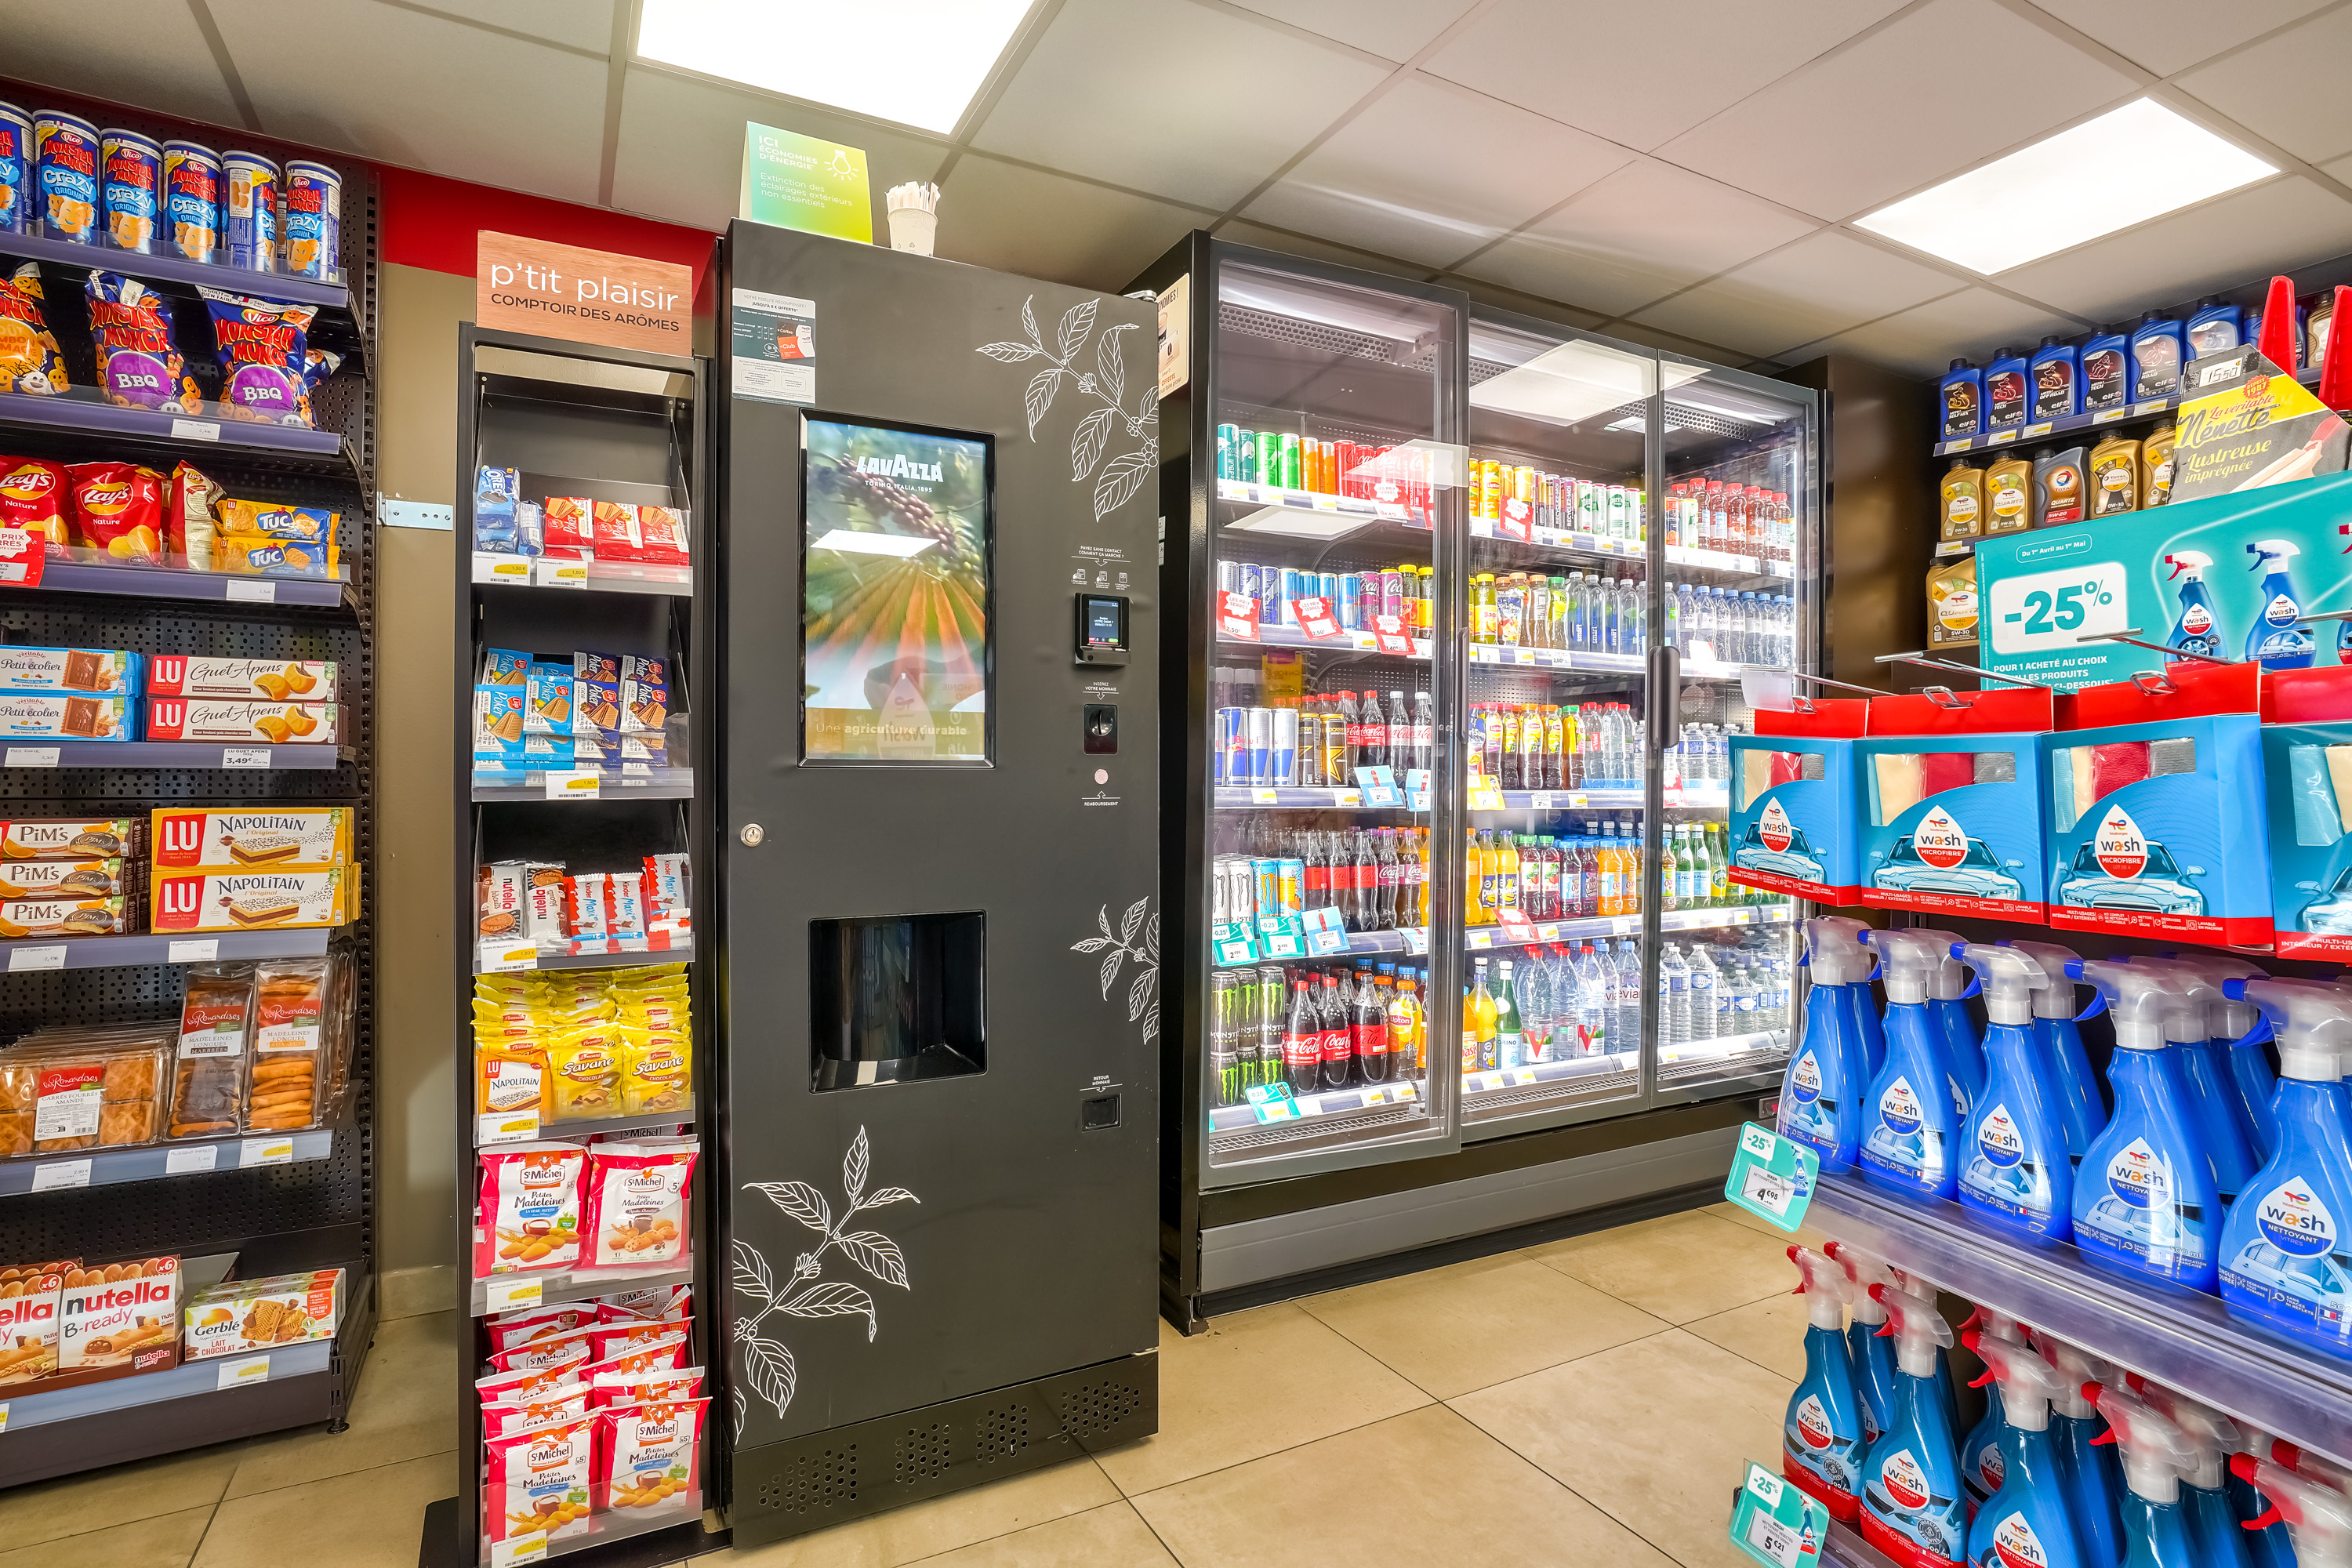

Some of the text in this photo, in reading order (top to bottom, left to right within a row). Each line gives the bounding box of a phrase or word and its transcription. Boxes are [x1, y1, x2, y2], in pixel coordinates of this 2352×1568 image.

[64, 133, 81, 143] Vico
[759, 135, 778, 147] ICI
[43, 140, 94, 168] MONSTER
[759, 145, 817, 165] ÉCONOMIES
[53, 154, 93, 176] MUNCH
[761, 172, 824, 192] Extinction des
[55, 187, 85, 201] ORIGINAL
[761, 181, 852, 206] éclairages extérieurs
[782, 193, 825, 208] essentiels
[578, 277, 678, 310] plaisir
[492, 294, 679, 331] COMPTOIR DES ARÔMES
[215, 319, 296, 352] MONSTER
[233, 343, 287, 368] MUNCH
[116, 374, 159, 388] BBQ
[2248, 378, 2266, 389] DEPUIS
[242, 387, 283, 401] BBQ
[2209, 395, 2275, 419] La véritable
[2178, 407, 2273, 444] Nénette
[2188, 440, 2272, 470] Lustreuse
[857, 454, 943, 481] LAVAZZA
[2184, 459, 2252, 483] imprégnée
[5, 500, 37, 510] Nature
[84, 488, 129, 504] Lay's
[564, 515, 577, 533] Poker
[2005, 579, 2112, 634] -25%
[16, 650, 46, 659] Véritable
[1994, 663, 2017, 672] POUR
[2025, 659, 2060, 670] ACHETÉ
[2078, 655, 2107, 664] CHOIX
[0, 659, 61, 671] Petit écolier
[156, 660, 181, 683] LU
[2042, 670, 2089, 680] PRODUITS
[493, 691, 508, 716] Poker
[589, 684, 602, 705] Poker
[816, 724, 967, 737] Une agriculture durable
[165, 822, 198, 851] LU
[1921, 833, 1960, 846] wash
[2101, 837, 2140, 851] wash
[503, 878, 516, 909] nutella
[538, 889, 546, 920] nutella
[583, 898, 597, 922] Maxi
[488, 1062, 499, 1073] LU
[560, 1057, 615, 1076] Savane
[1886, 1100, 1917, 1116] wash
[1886, 1113, 1914, 1124] NETTOYANT
[1984, 1129, 2017, 1148] wash
[1984, 1144, 2014, 1157] NETTOYANT
[2116, 1166, 2163, 1187] wash
[514, 1197, 564, 1208] Madeleines
[2282, 1202, 2309, 1211] TotalEnergies
[2072, 1221, 2089, 1231] LONGUE
[2267, 1206, 2325, 1233] wash
[2074, 1226, 2089, 1236] DURÉE
[2268, 1224, 2318, 1243] NETTOYANT
[2281, 1236, 2303, 1247] VITRES
[66, 1283, 169, 1315] nutella
[64, 1309, 133, 1338] B-ready
[195, 1321, 239, 1335] Gerblé
[201, 1345, 234, 1355] CHOCOLAT
[630, 1451, 679, 1464] Madeleines
[1888, 1465, 1923, 1493] wash
[1889, 1480, 1918, 1501] NETTOYANT
[1999, 1532, 2040, 1561] wash
